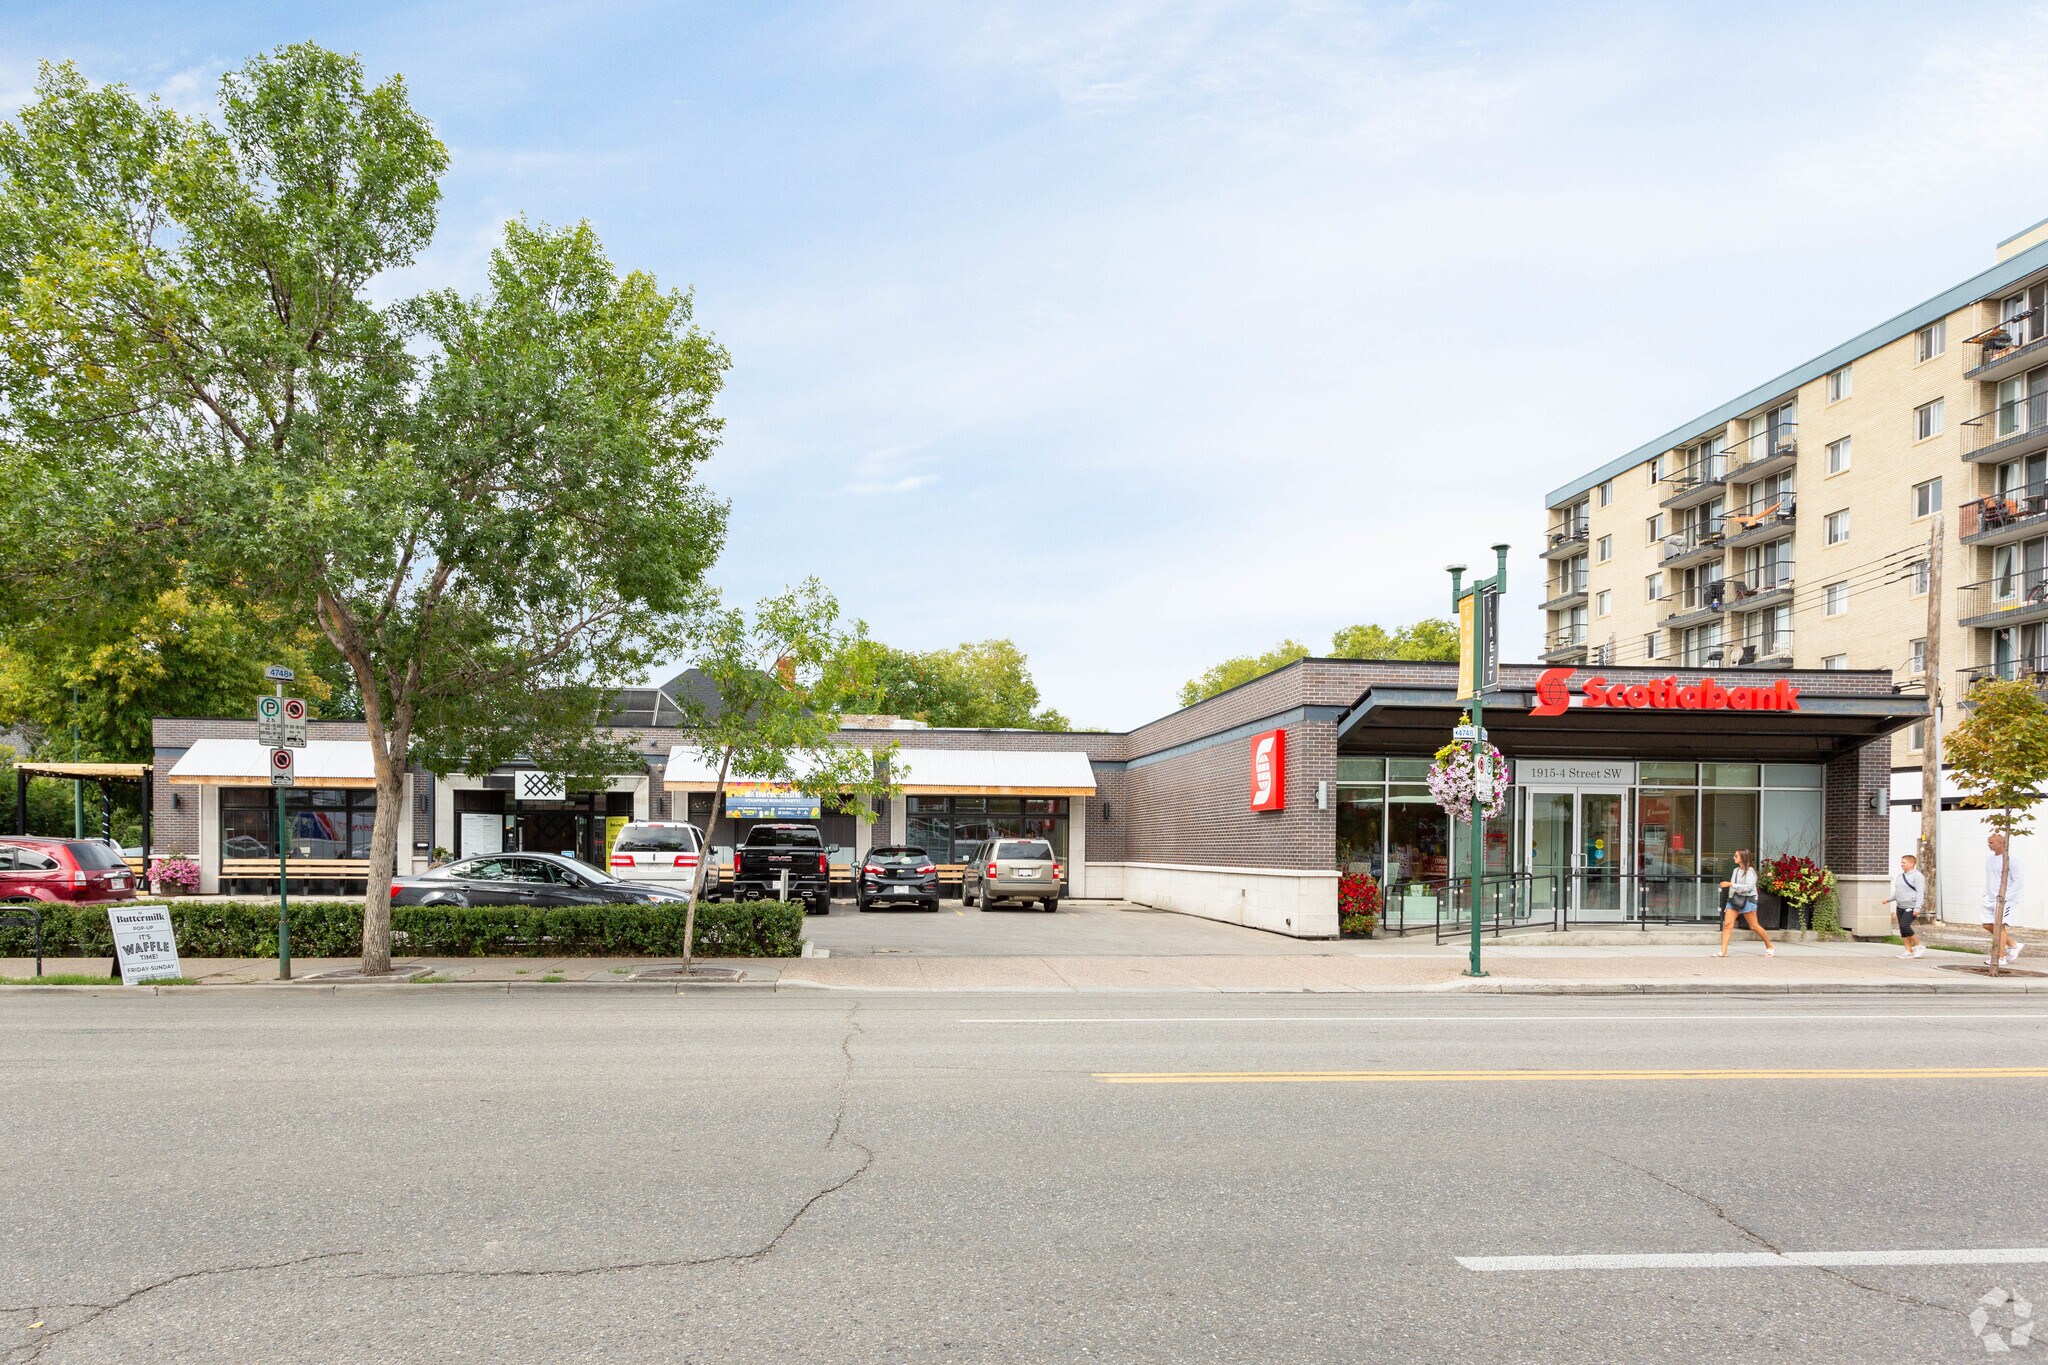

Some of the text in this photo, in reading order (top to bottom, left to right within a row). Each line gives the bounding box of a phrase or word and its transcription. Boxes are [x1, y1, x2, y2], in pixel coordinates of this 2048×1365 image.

[1464, 606, 1472, 687] FOURTH
[270, 669, 289, 678] 4748
[1582, 675, 1801, 710] Scotiabank
[266, 702, 276, 713] P
[1531, 768, 1622, 779] 1915-4 Street SW
[116, 913, 165, 923] Buttermilk
[122, 941, 170, 956] WAFFLE
